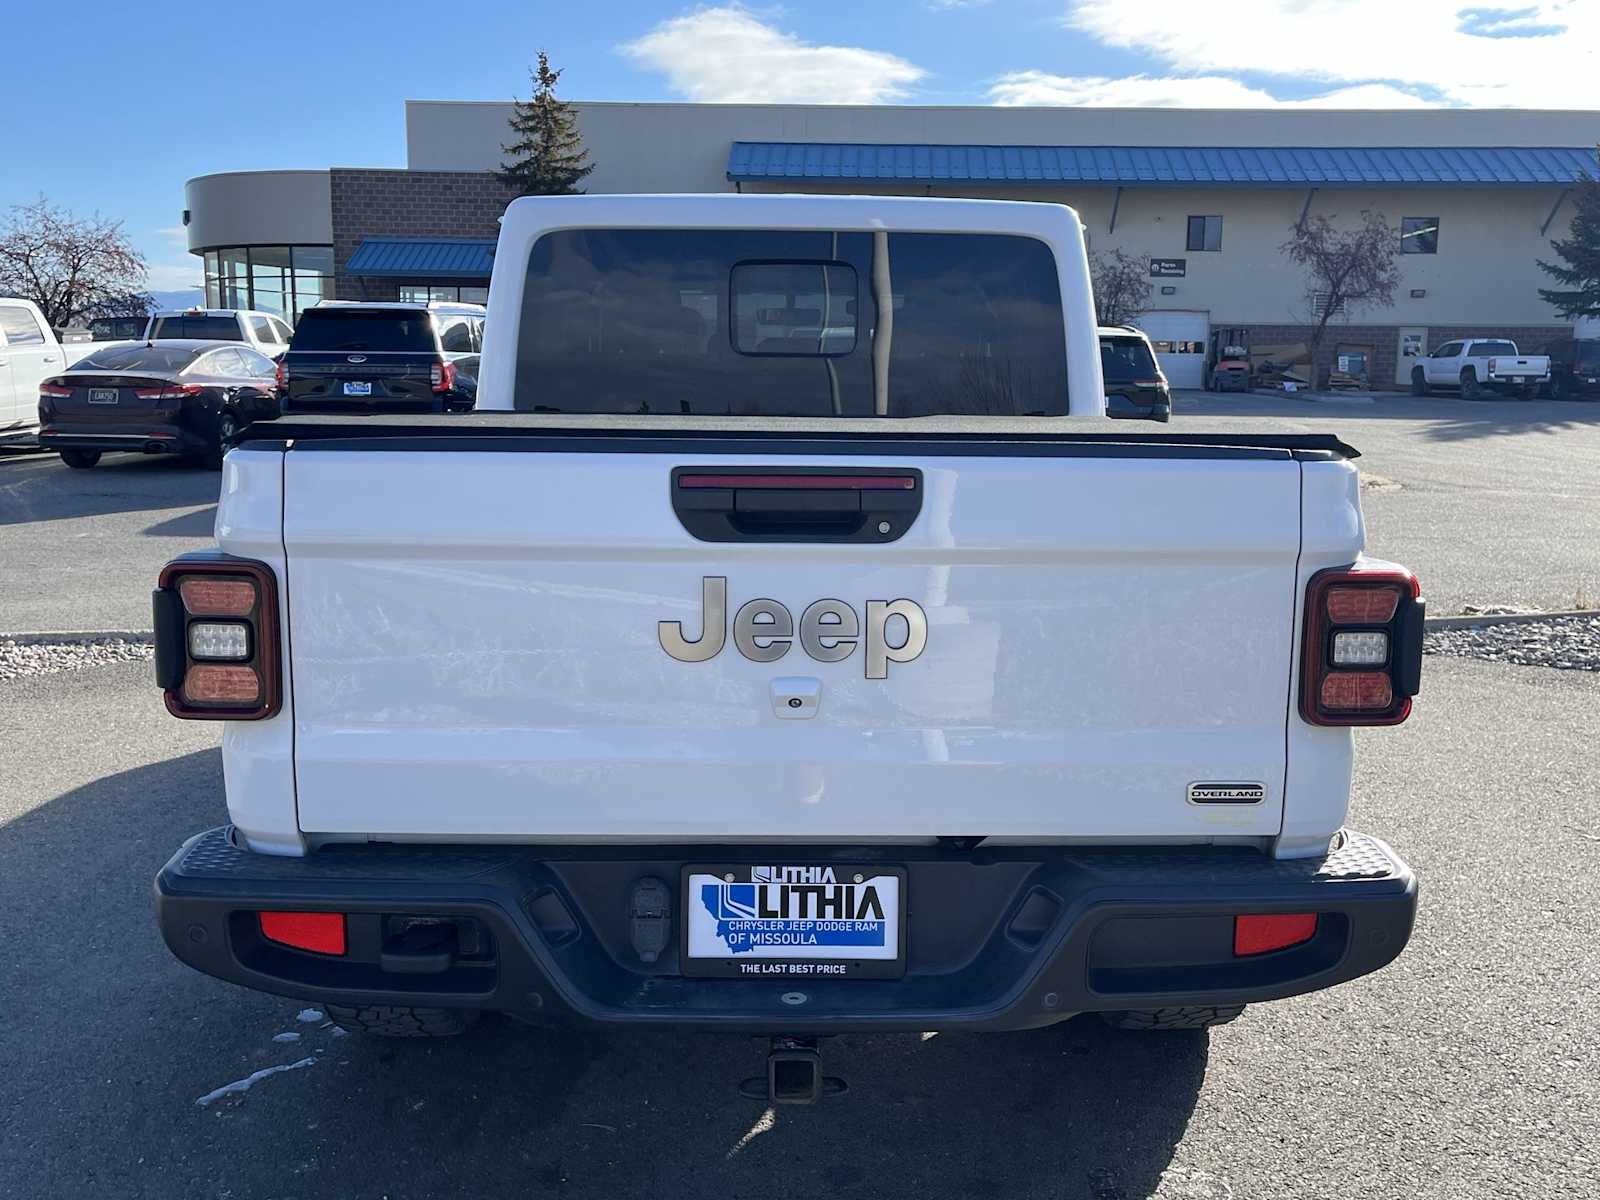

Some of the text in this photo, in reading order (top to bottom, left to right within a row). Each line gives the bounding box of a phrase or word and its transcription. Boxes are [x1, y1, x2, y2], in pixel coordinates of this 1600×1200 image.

[658, 576, 928, 679] Jeep
[770, 866, 836, 883] LITHIA
[758, 885, 885, 919] LITHIA
[728, 921, 878, 932] CHRYSLER JEEP DODGE RAM
[728, 933, 817, 945] OF MISSOULA
[740, 964, 847, 974] THE LAST BEST PRICE
